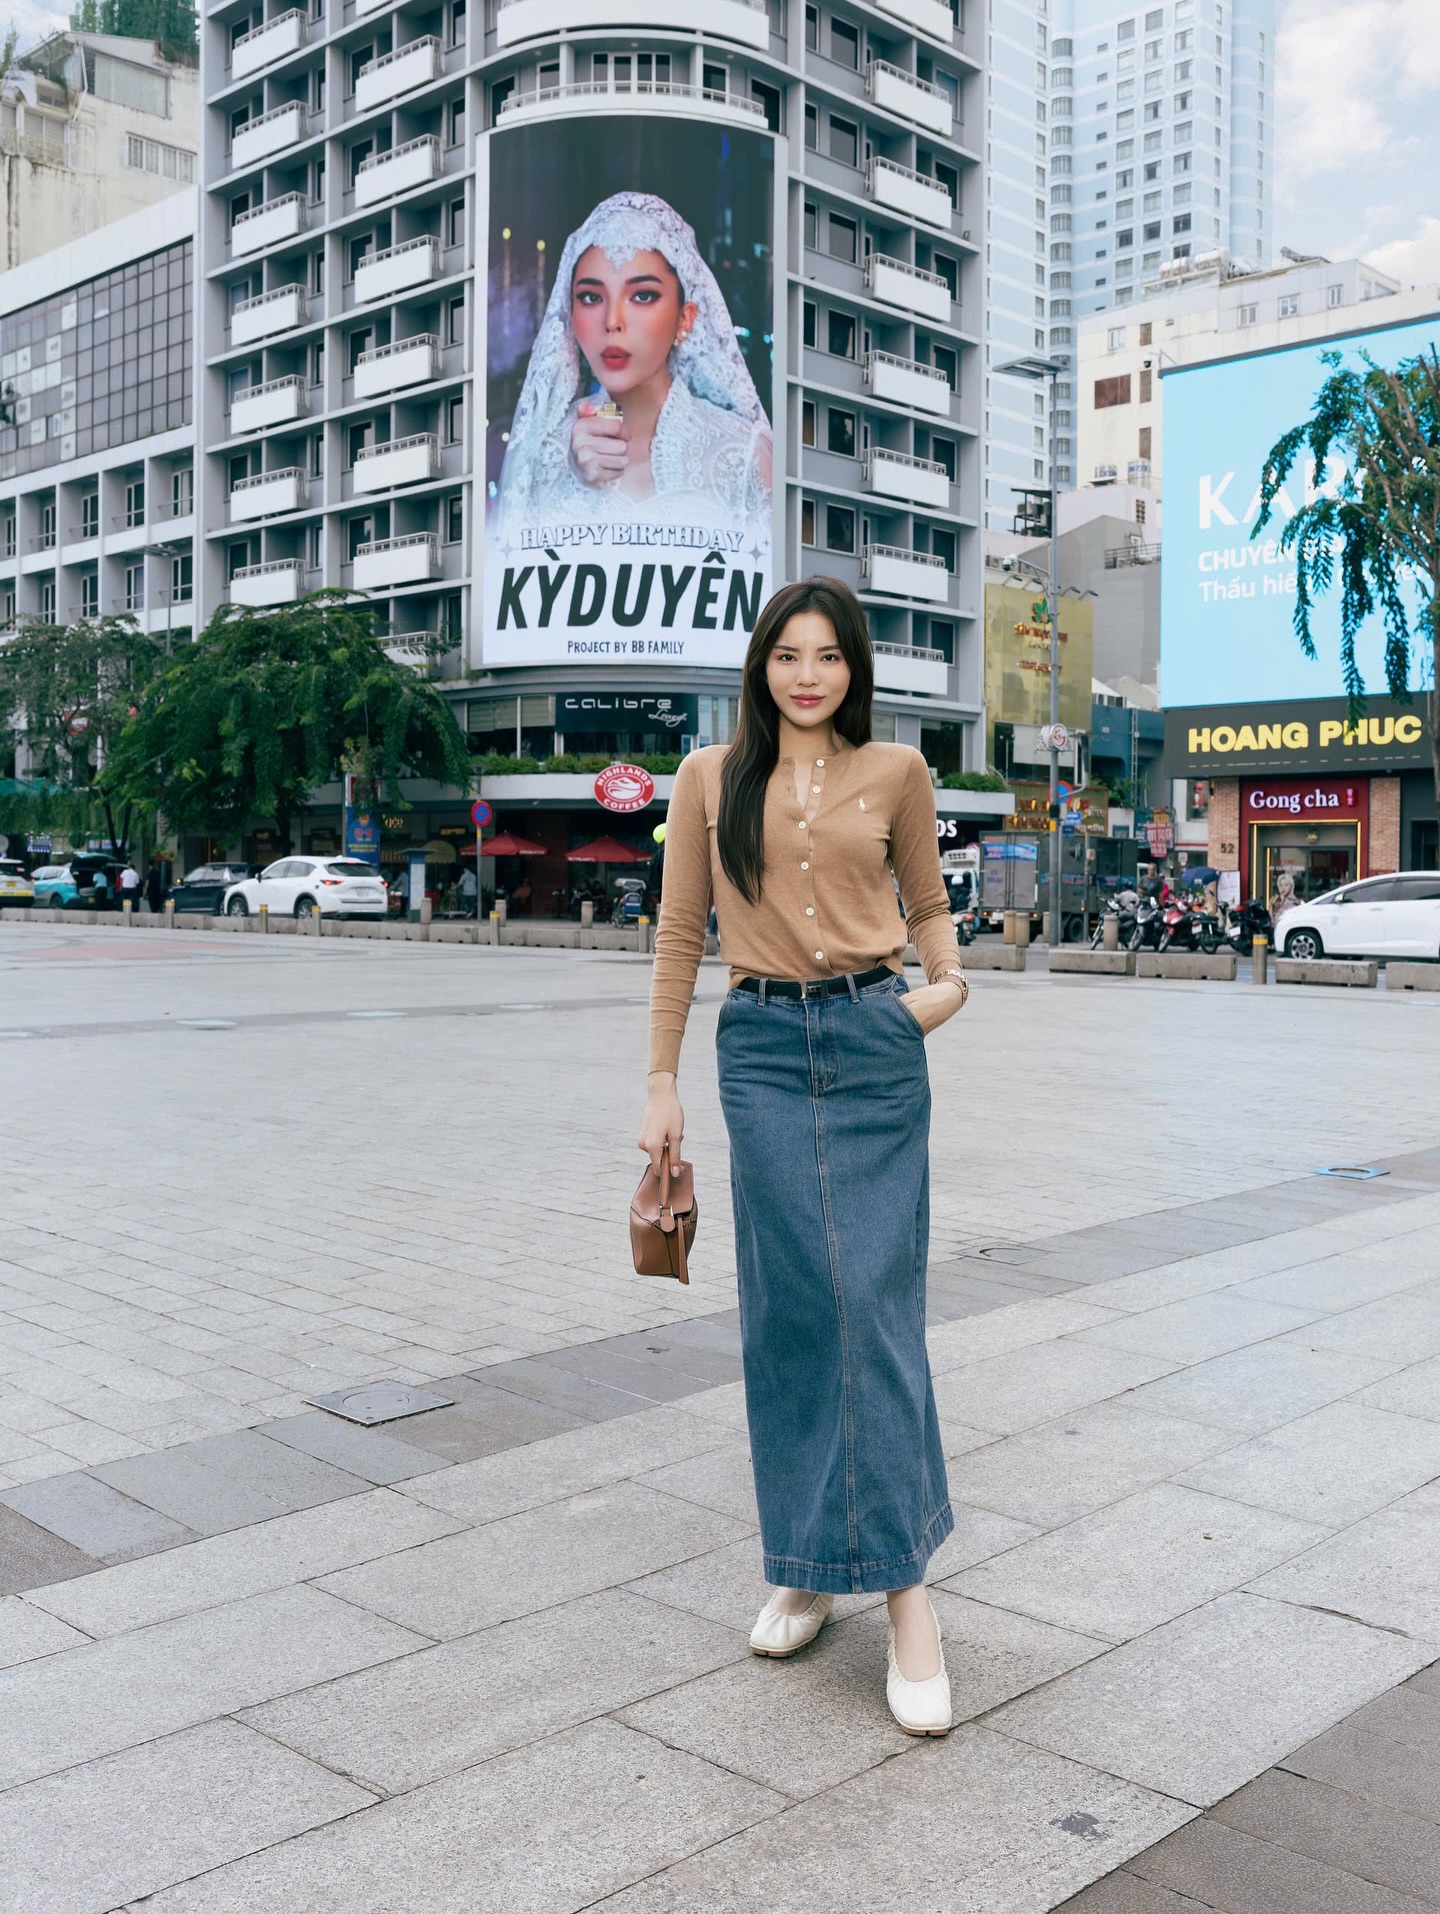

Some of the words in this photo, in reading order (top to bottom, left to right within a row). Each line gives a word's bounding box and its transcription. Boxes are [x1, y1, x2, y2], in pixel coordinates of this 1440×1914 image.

[521, 525, 609, 550] HAPPY
[611, 522, 745, 553] BIRTHDAY
[1198, 539, 1296, 573] CHUYÊN
[1198, 575, 1256, 602] Thấu
[567, 640, 611, 654] PROJECT
[614, 641, 628, 653] BY
[631, 640, 645, 653] BB
[648, 641, 685, 655] FAMILY
[648, 709, 687, 728] Lounge
[1188, 721, 1309, 754] HOANG
[1319, 715, 1423, 748] PHUC
[596, 765, 652, 787] HIGHLANDS
[602, 798, 647, 811] COFFEE
[1249, 790, 1301, 813] Gong
[1304, 788, 1340, 807] cha
[1220, 843, 1235, 854] 52
